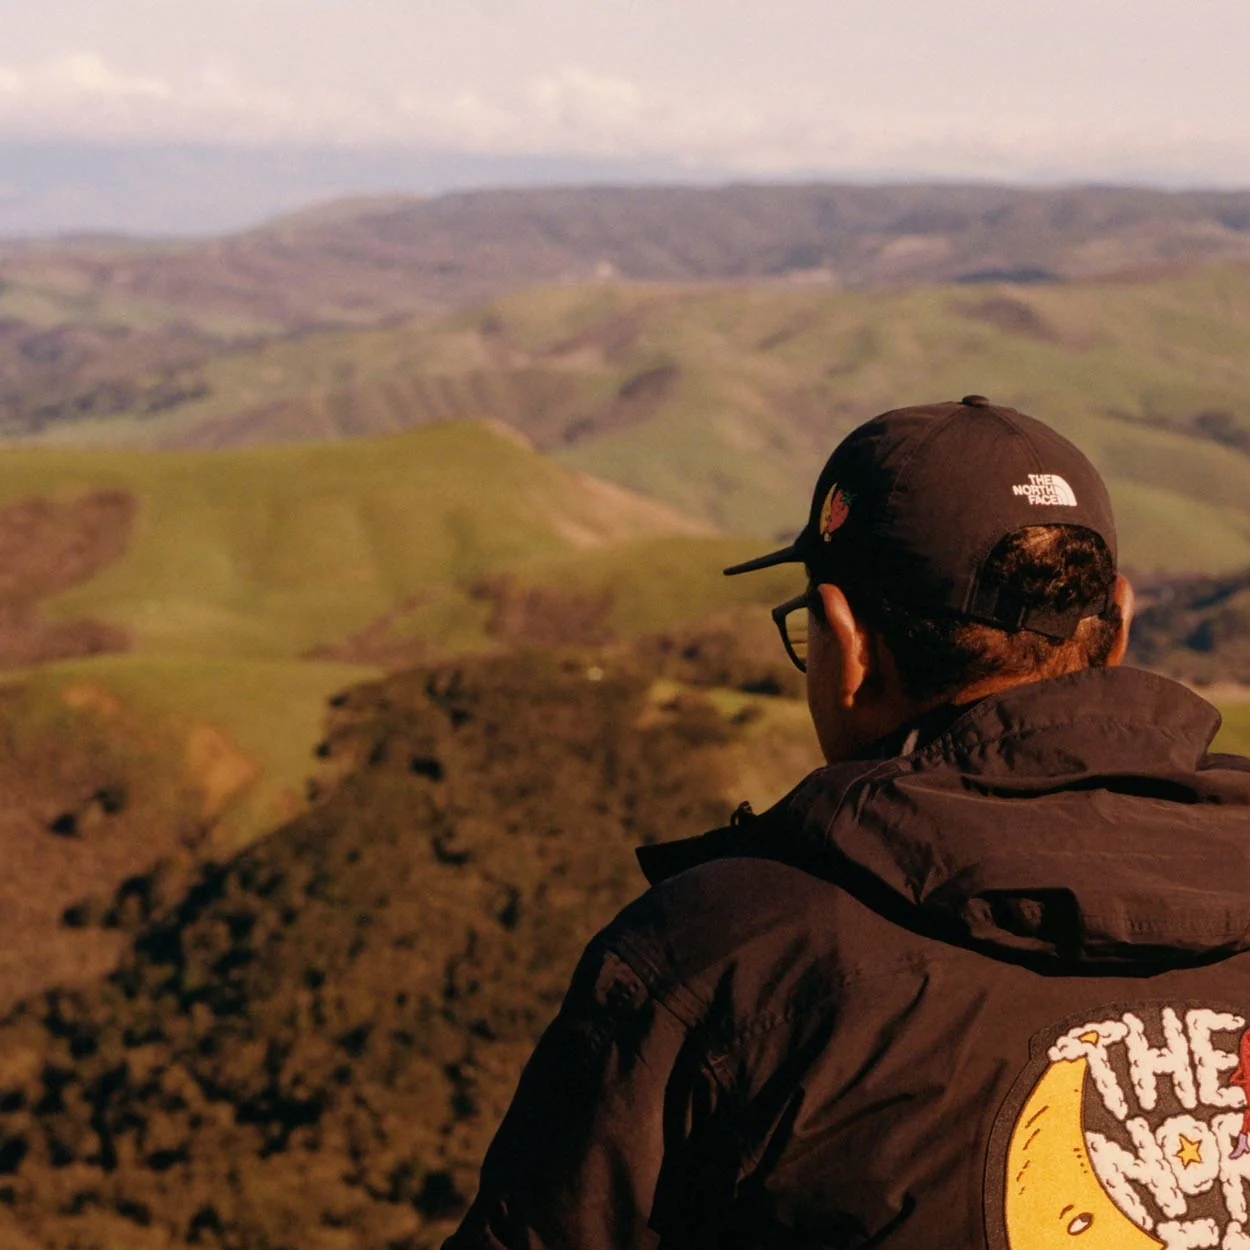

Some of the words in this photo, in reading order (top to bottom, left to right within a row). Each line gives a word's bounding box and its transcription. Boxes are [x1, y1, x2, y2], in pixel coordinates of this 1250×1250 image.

[1028, 473, 1053, 485] THE
[1012, 485, 1054, 496] NORTH
[1028, 495, 1058, 505] FACE
[1048, 1008, 1246, 1119] THE
